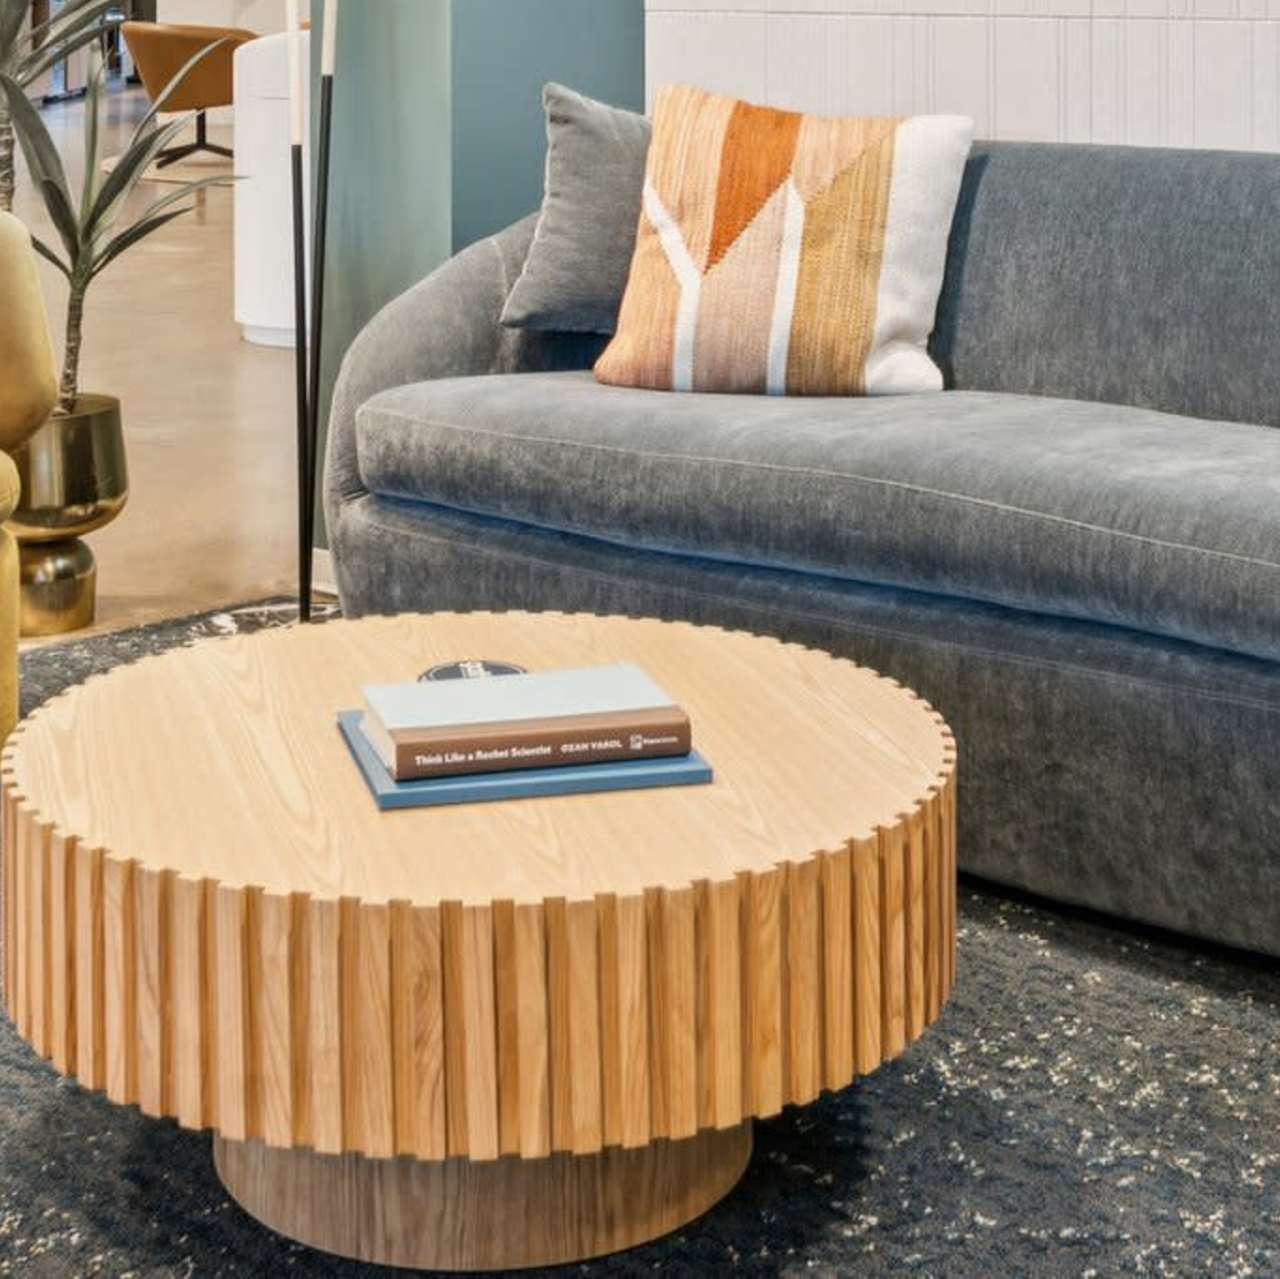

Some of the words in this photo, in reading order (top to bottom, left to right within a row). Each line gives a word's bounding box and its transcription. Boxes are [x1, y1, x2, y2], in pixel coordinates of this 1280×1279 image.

[415, 751, 443, 766] Think
[444, 752, 466, 762] Like
[475, 748, 509, 761] Rocket
[510, 744, 552, 758] Scientist
